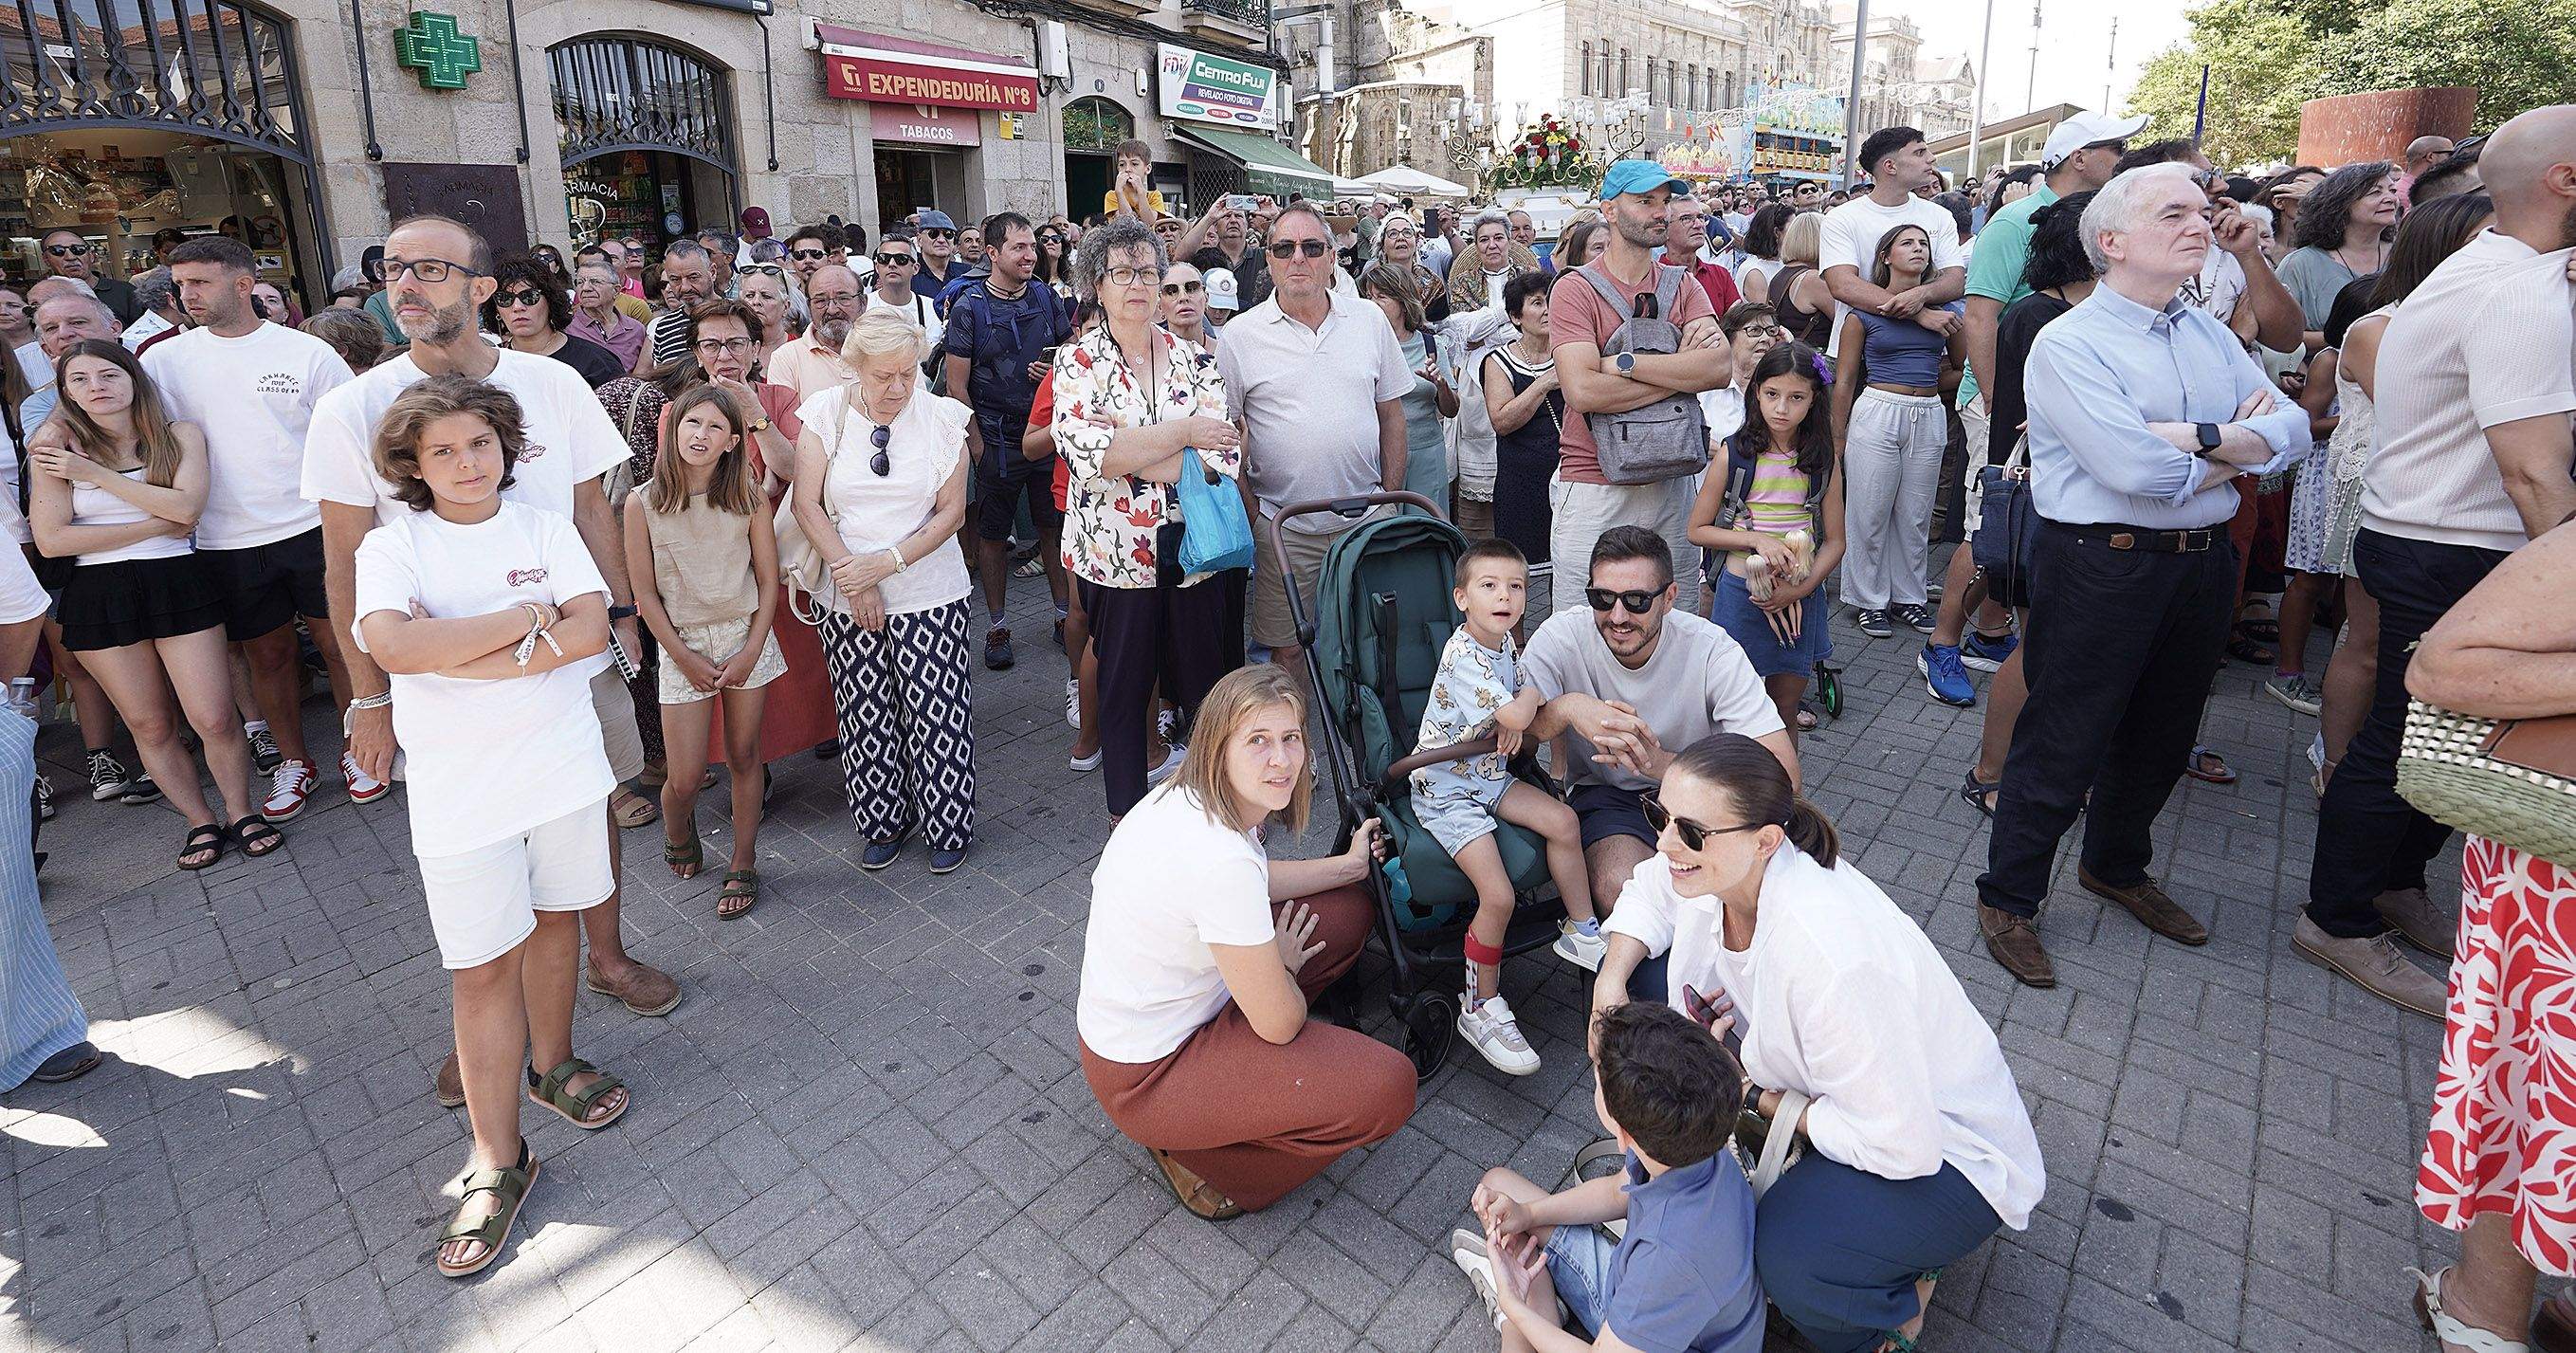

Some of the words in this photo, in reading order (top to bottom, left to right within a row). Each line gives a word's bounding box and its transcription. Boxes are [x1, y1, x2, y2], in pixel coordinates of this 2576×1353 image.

[868, 72, 1001, 104] EXPENDEDURÍA
[1197, 88, 1224, 101] REVELADO
[1223, 93, 1236, 103] FOTO
[1236, 96, 1254, 106] DIGITAL
[899, 124, 955, 140] TABACOS
[562, 181, 618, 201] ARMACIA
